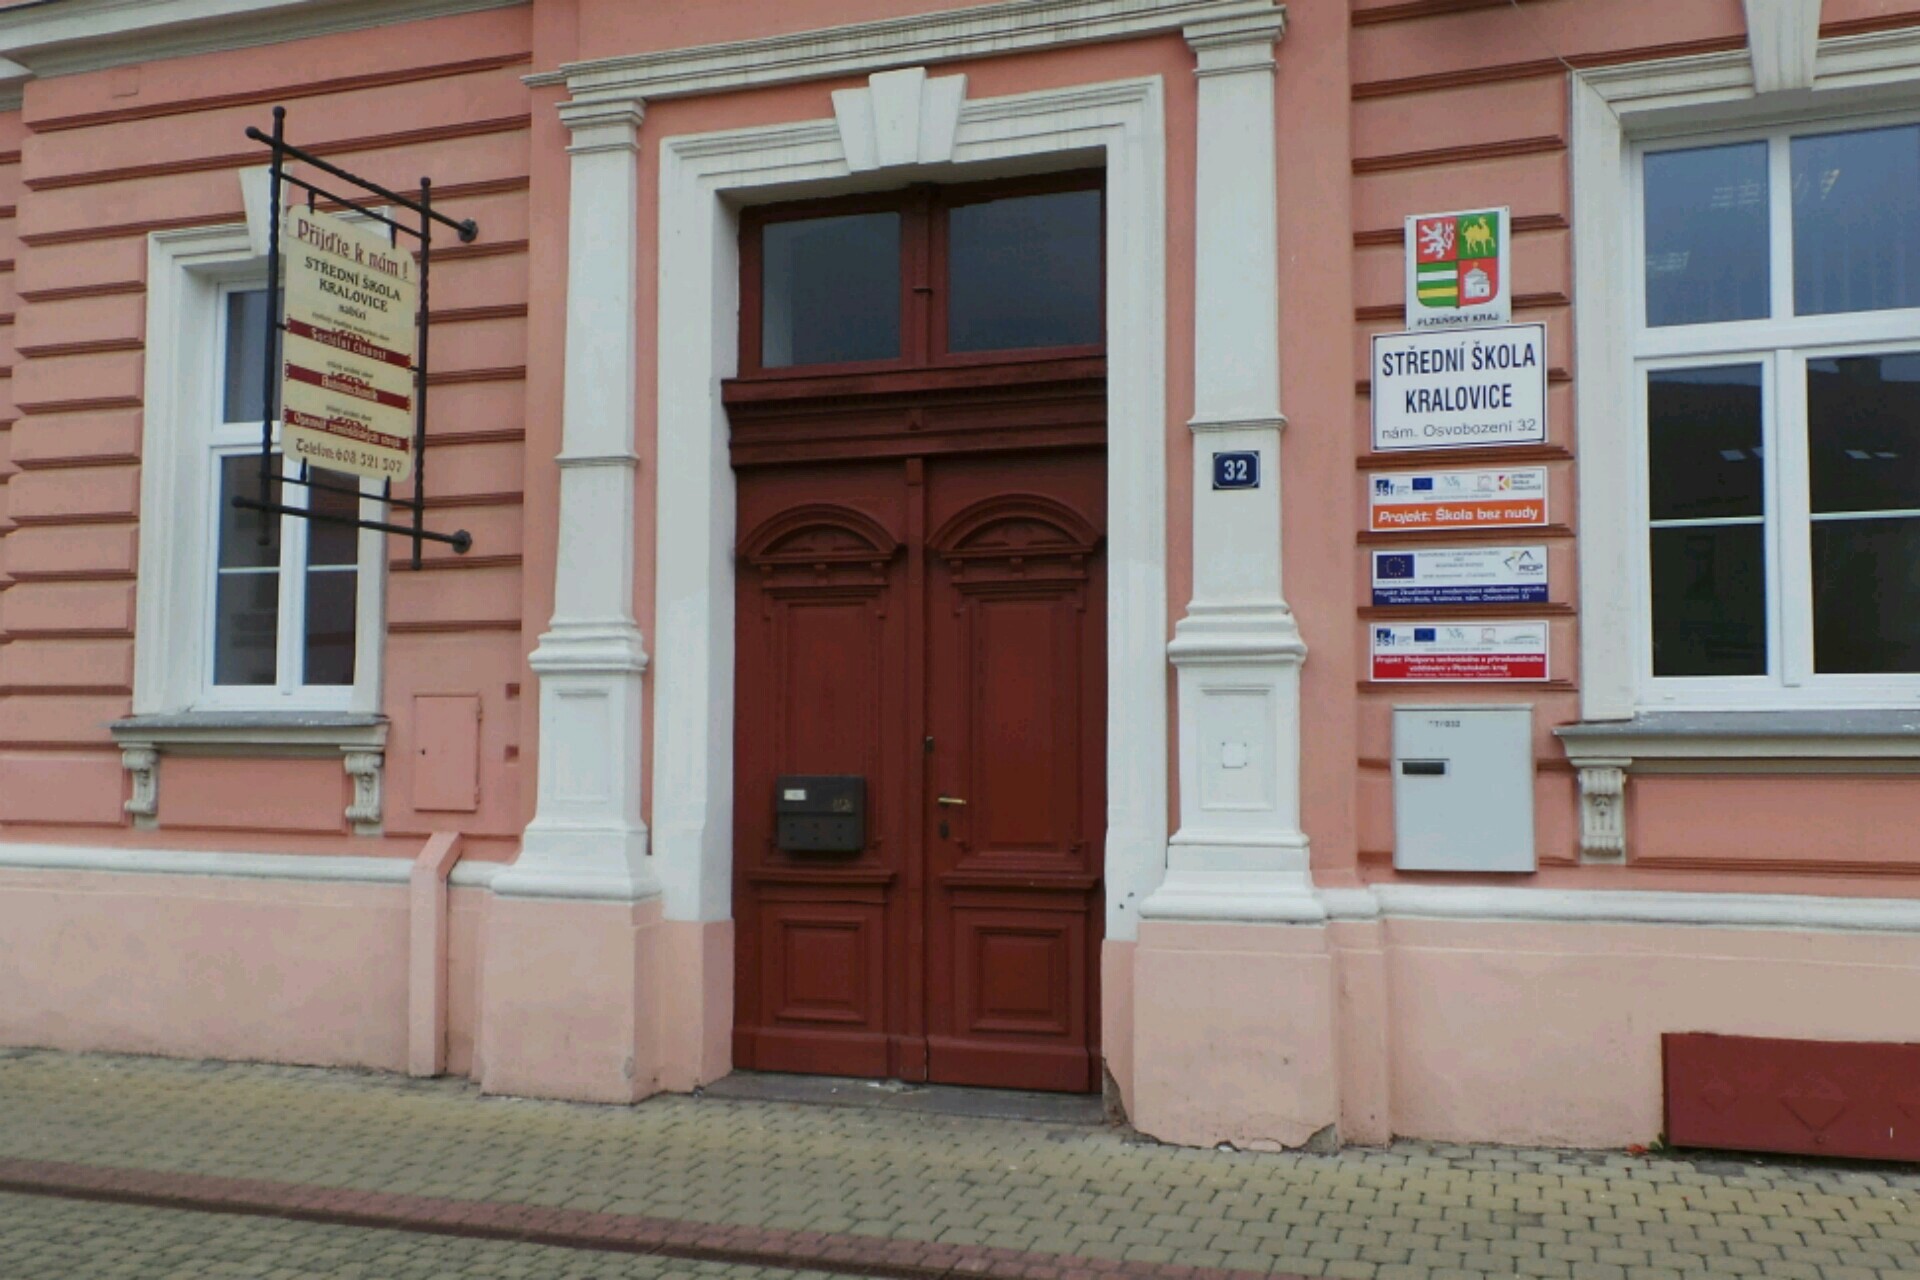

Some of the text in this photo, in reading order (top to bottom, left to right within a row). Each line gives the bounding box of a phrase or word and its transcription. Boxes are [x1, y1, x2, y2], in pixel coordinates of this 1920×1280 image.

[355, 242, 364, 265] k
[304, 256, 402, 301] STŘEDNÍ ŠKOLA
[319, 278, 389, 313] KRALOVICE
[1417, 313, 1499, 327] PLZEŇSKÝ KRAJ
[1382, 340, 1536, 376] STŘEDNÍ ŠKOLA
[1405, 384, 1512, 413] KRALOVICE
[1382, 418, 1537, 440] nám. Osvobození 32
[1224, 459, 1248, 481] 32
[1378, 506, 1538, 524] Projekt: Škola bez nudy
